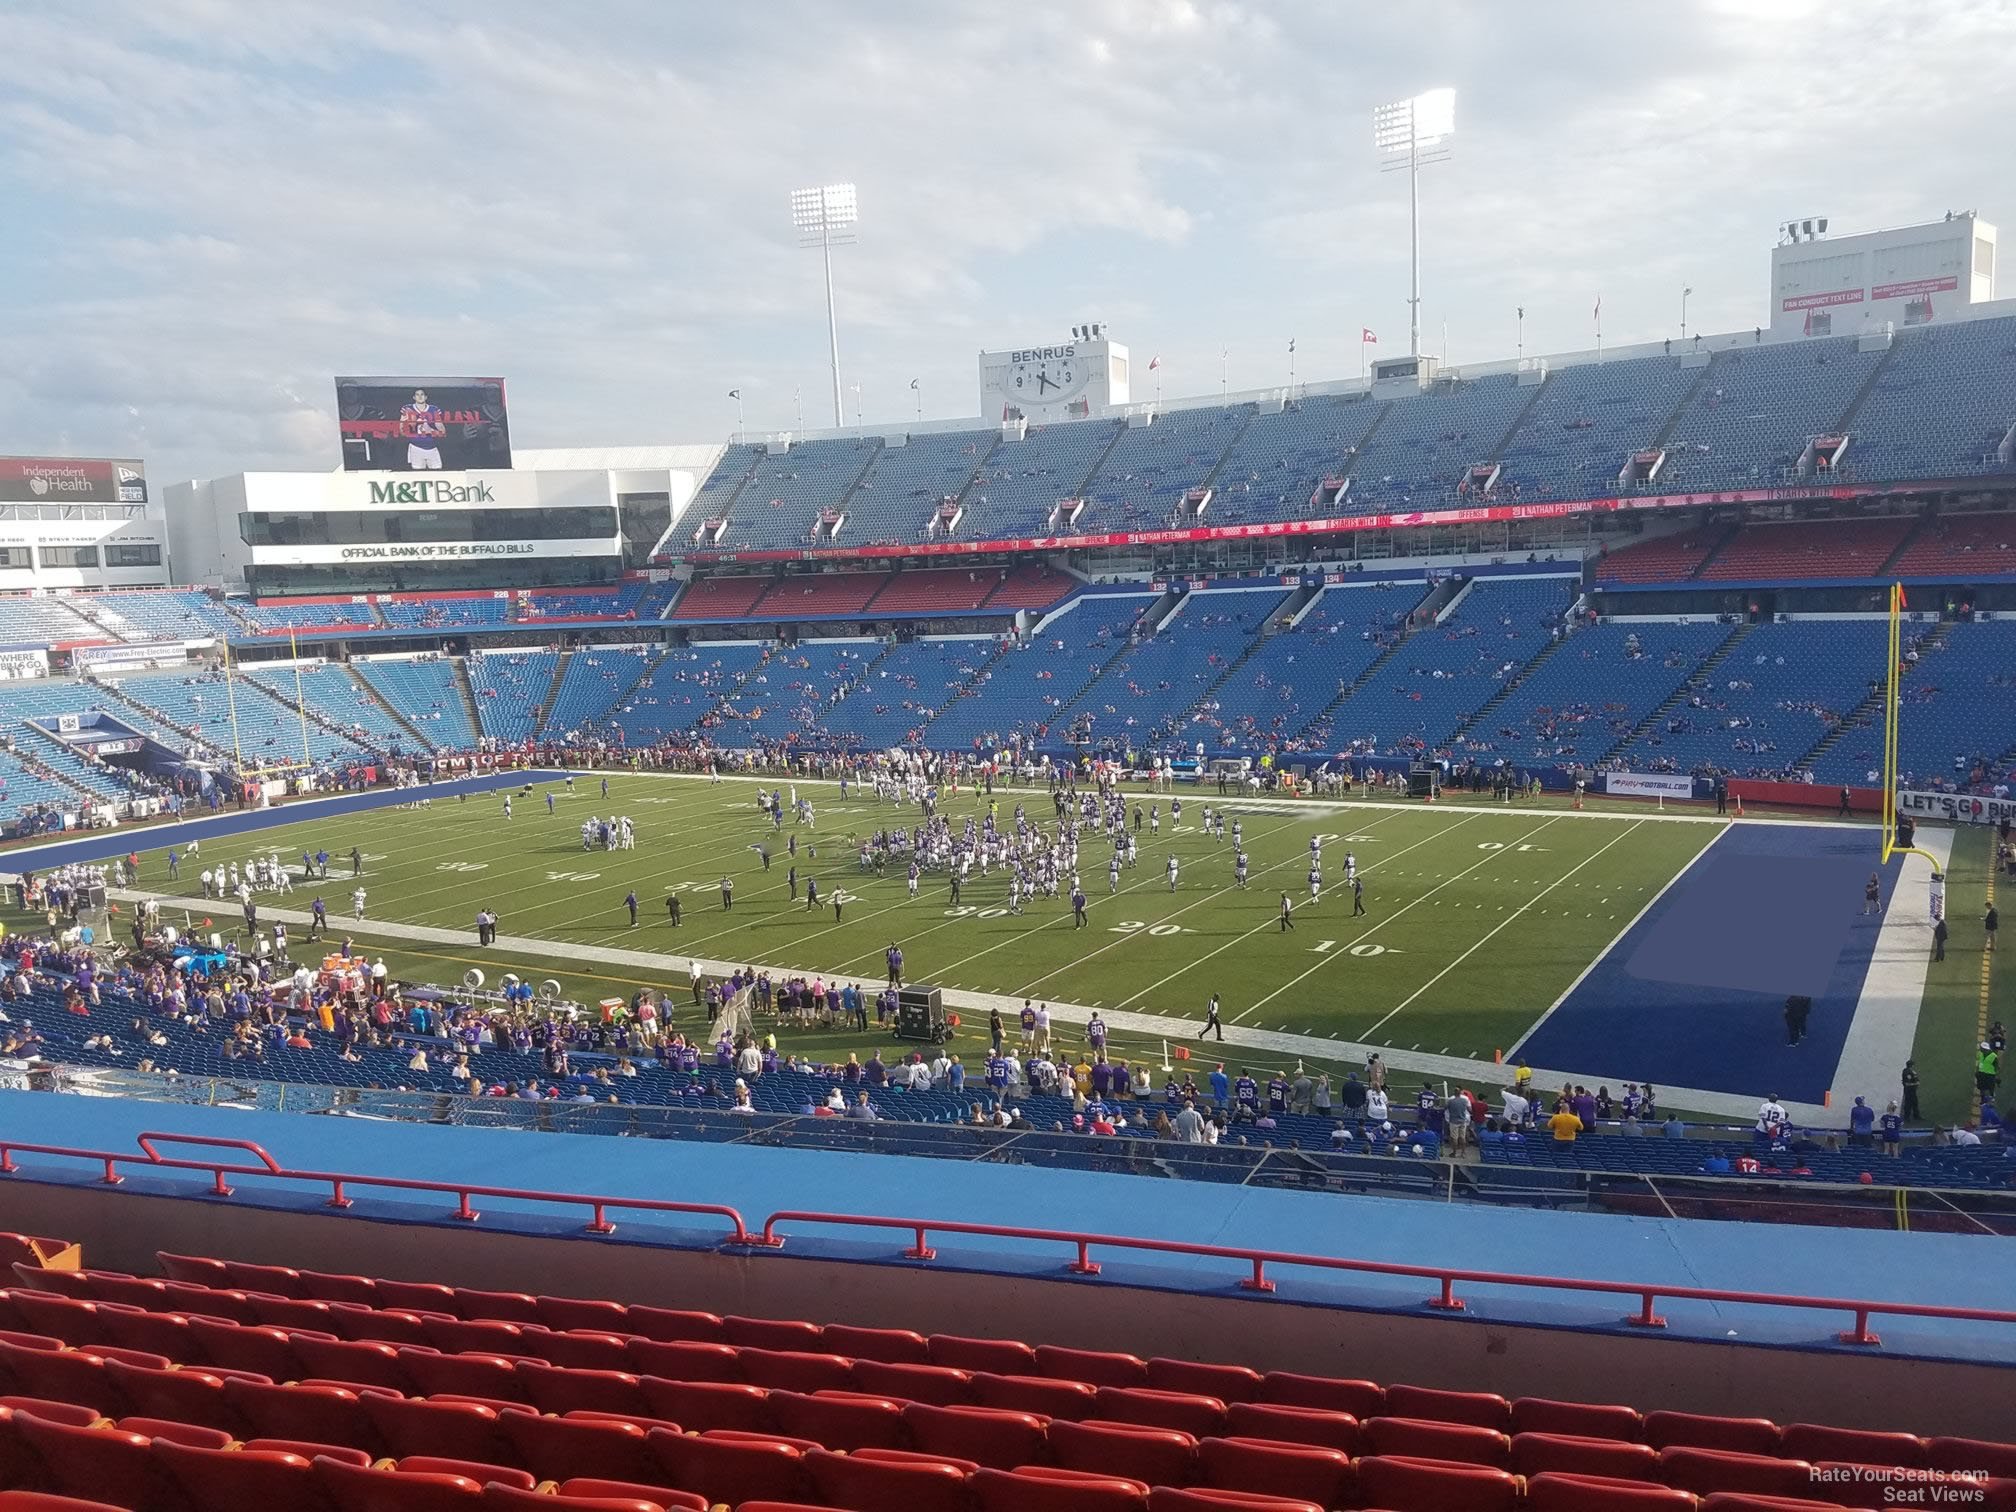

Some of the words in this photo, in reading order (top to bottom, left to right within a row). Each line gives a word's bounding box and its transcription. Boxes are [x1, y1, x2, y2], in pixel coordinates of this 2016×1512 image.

[1012, 346, 1075, 363] BENRUS
[1016, 376, 1023, 388] 9
[1065, 371, 1072, 383] 3
[23, 466, 86, 480] Independent
[49, 476, 93, 491] Health
[120, 492, 143, 500] FIELD
[1458, 510, 1485, 518] OFFENSE
[1526, 504, 1554, 515] NATHAN
[1555, 502, 1592, 513] PETERMAN
[1333, 519, 1357, 528] STARTS
[1357, 518, 1375, 527] WITH
[1139, 533, 1160, 541] NATHAN
[1161, 530, 1191, 540] PETERMAN
[342, 548, 389, 558] OFFICIAL
[390, 547, 420, 557] BANK
[421, 547, 435, 556] OF
[436, 546, 458, 556] THE
[460, 545, 508, 555] BUFFALO
[508, 544, 534, 553] BILLS
[636, 569, 649, 577] 227
[1285, 576, 1300, 585] 133
[1324, 575, 1339, 584] 134
[1153, 583, 1167, 591] 132
[1189, 581, 1203, 590] 133
[0, 652, 35, 662] WHERE
[112, 647, 186, 659] www.Frey-Electric.com
[1902, 794, 1956, 812] LET'S
[1107, 920, 1181, 936] 20
[1305, 940, 1385, 957] 10
[1091, 1025, 1103, 1036] 80
[993, 1067, 1005, 1077] 23
[1271, 1089, 1282, 1100] 28
[1421, 1099, 1433, 1109] 84
[1766, 1110, 1780, 1123] 12
[1742, 1163, 1757, 1173] 14
